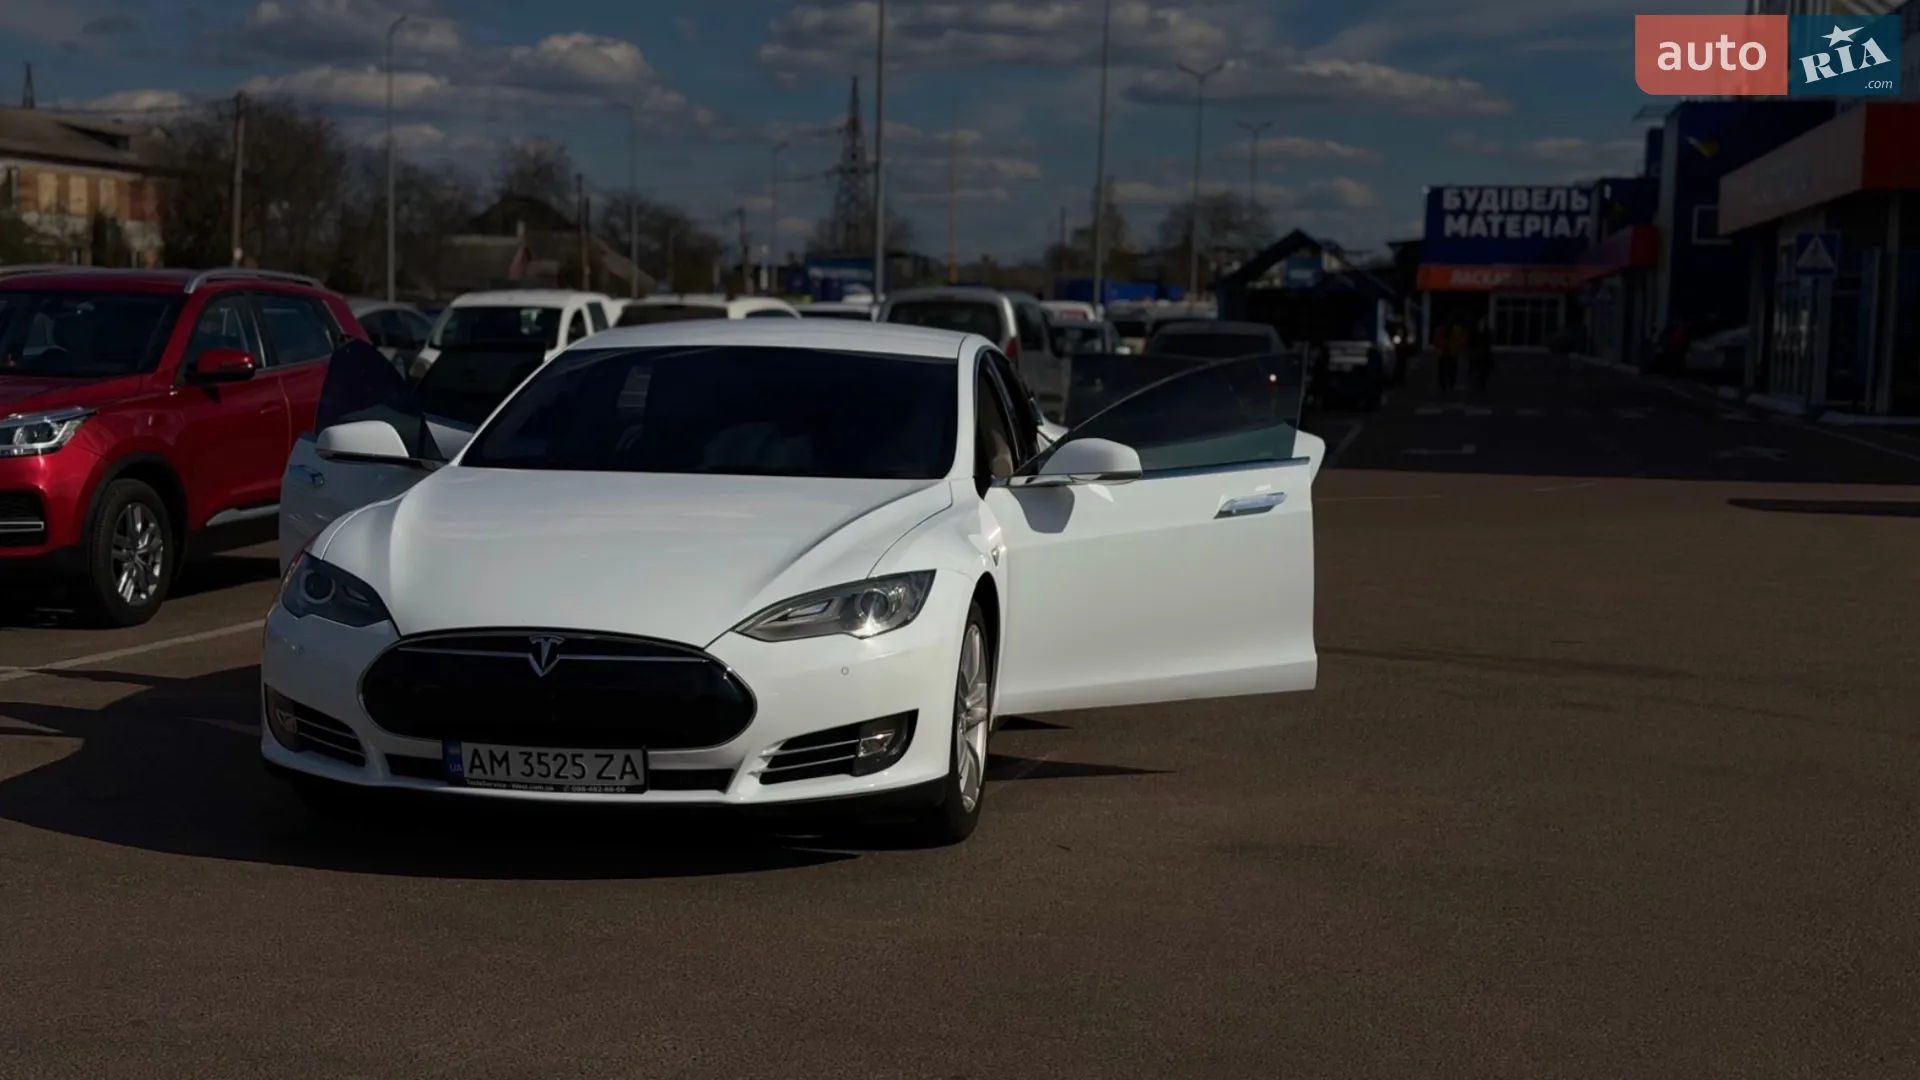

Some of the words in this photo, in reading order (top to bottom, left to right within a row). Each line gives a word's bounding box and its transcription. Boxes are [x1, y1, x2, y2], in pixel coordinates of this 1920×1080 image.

[1442, 187, 1589, 213] БУДІВЕЛЬ
[468, 748, 511, 776] AM
[519, 751, 588, 780] 3525
[594, 754, 641, 781] ZA
